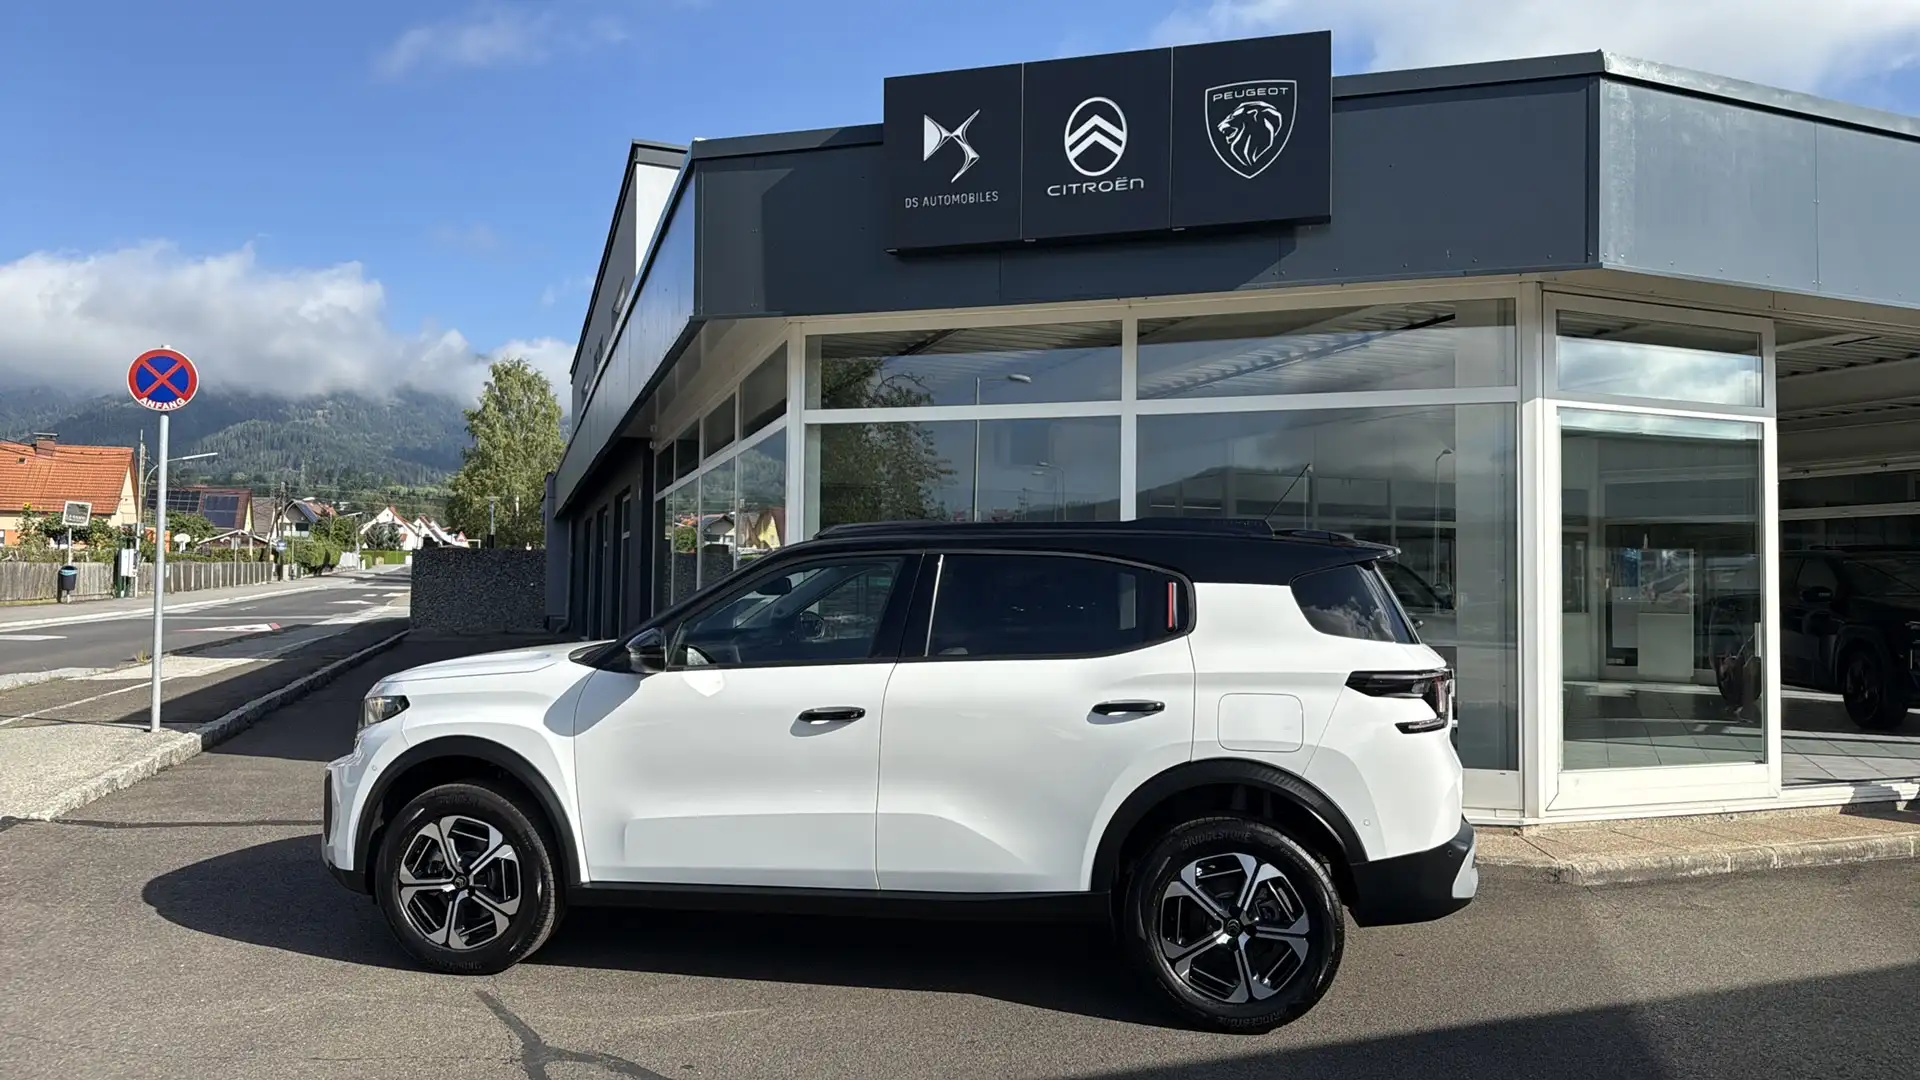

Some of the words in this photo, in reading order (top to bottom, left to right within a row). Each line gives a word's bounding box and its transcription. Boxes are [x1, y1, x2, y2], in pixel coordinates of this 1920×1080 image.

[1213, 87, 1289, 102] PEUGEOT
[1047, 177, 1144, 196] CITROËN
[905, 197, 919, 208] DS
[922, 190, 999, 207] AUTOMOBILES
[140, 397, 186, 410] ANFANG
